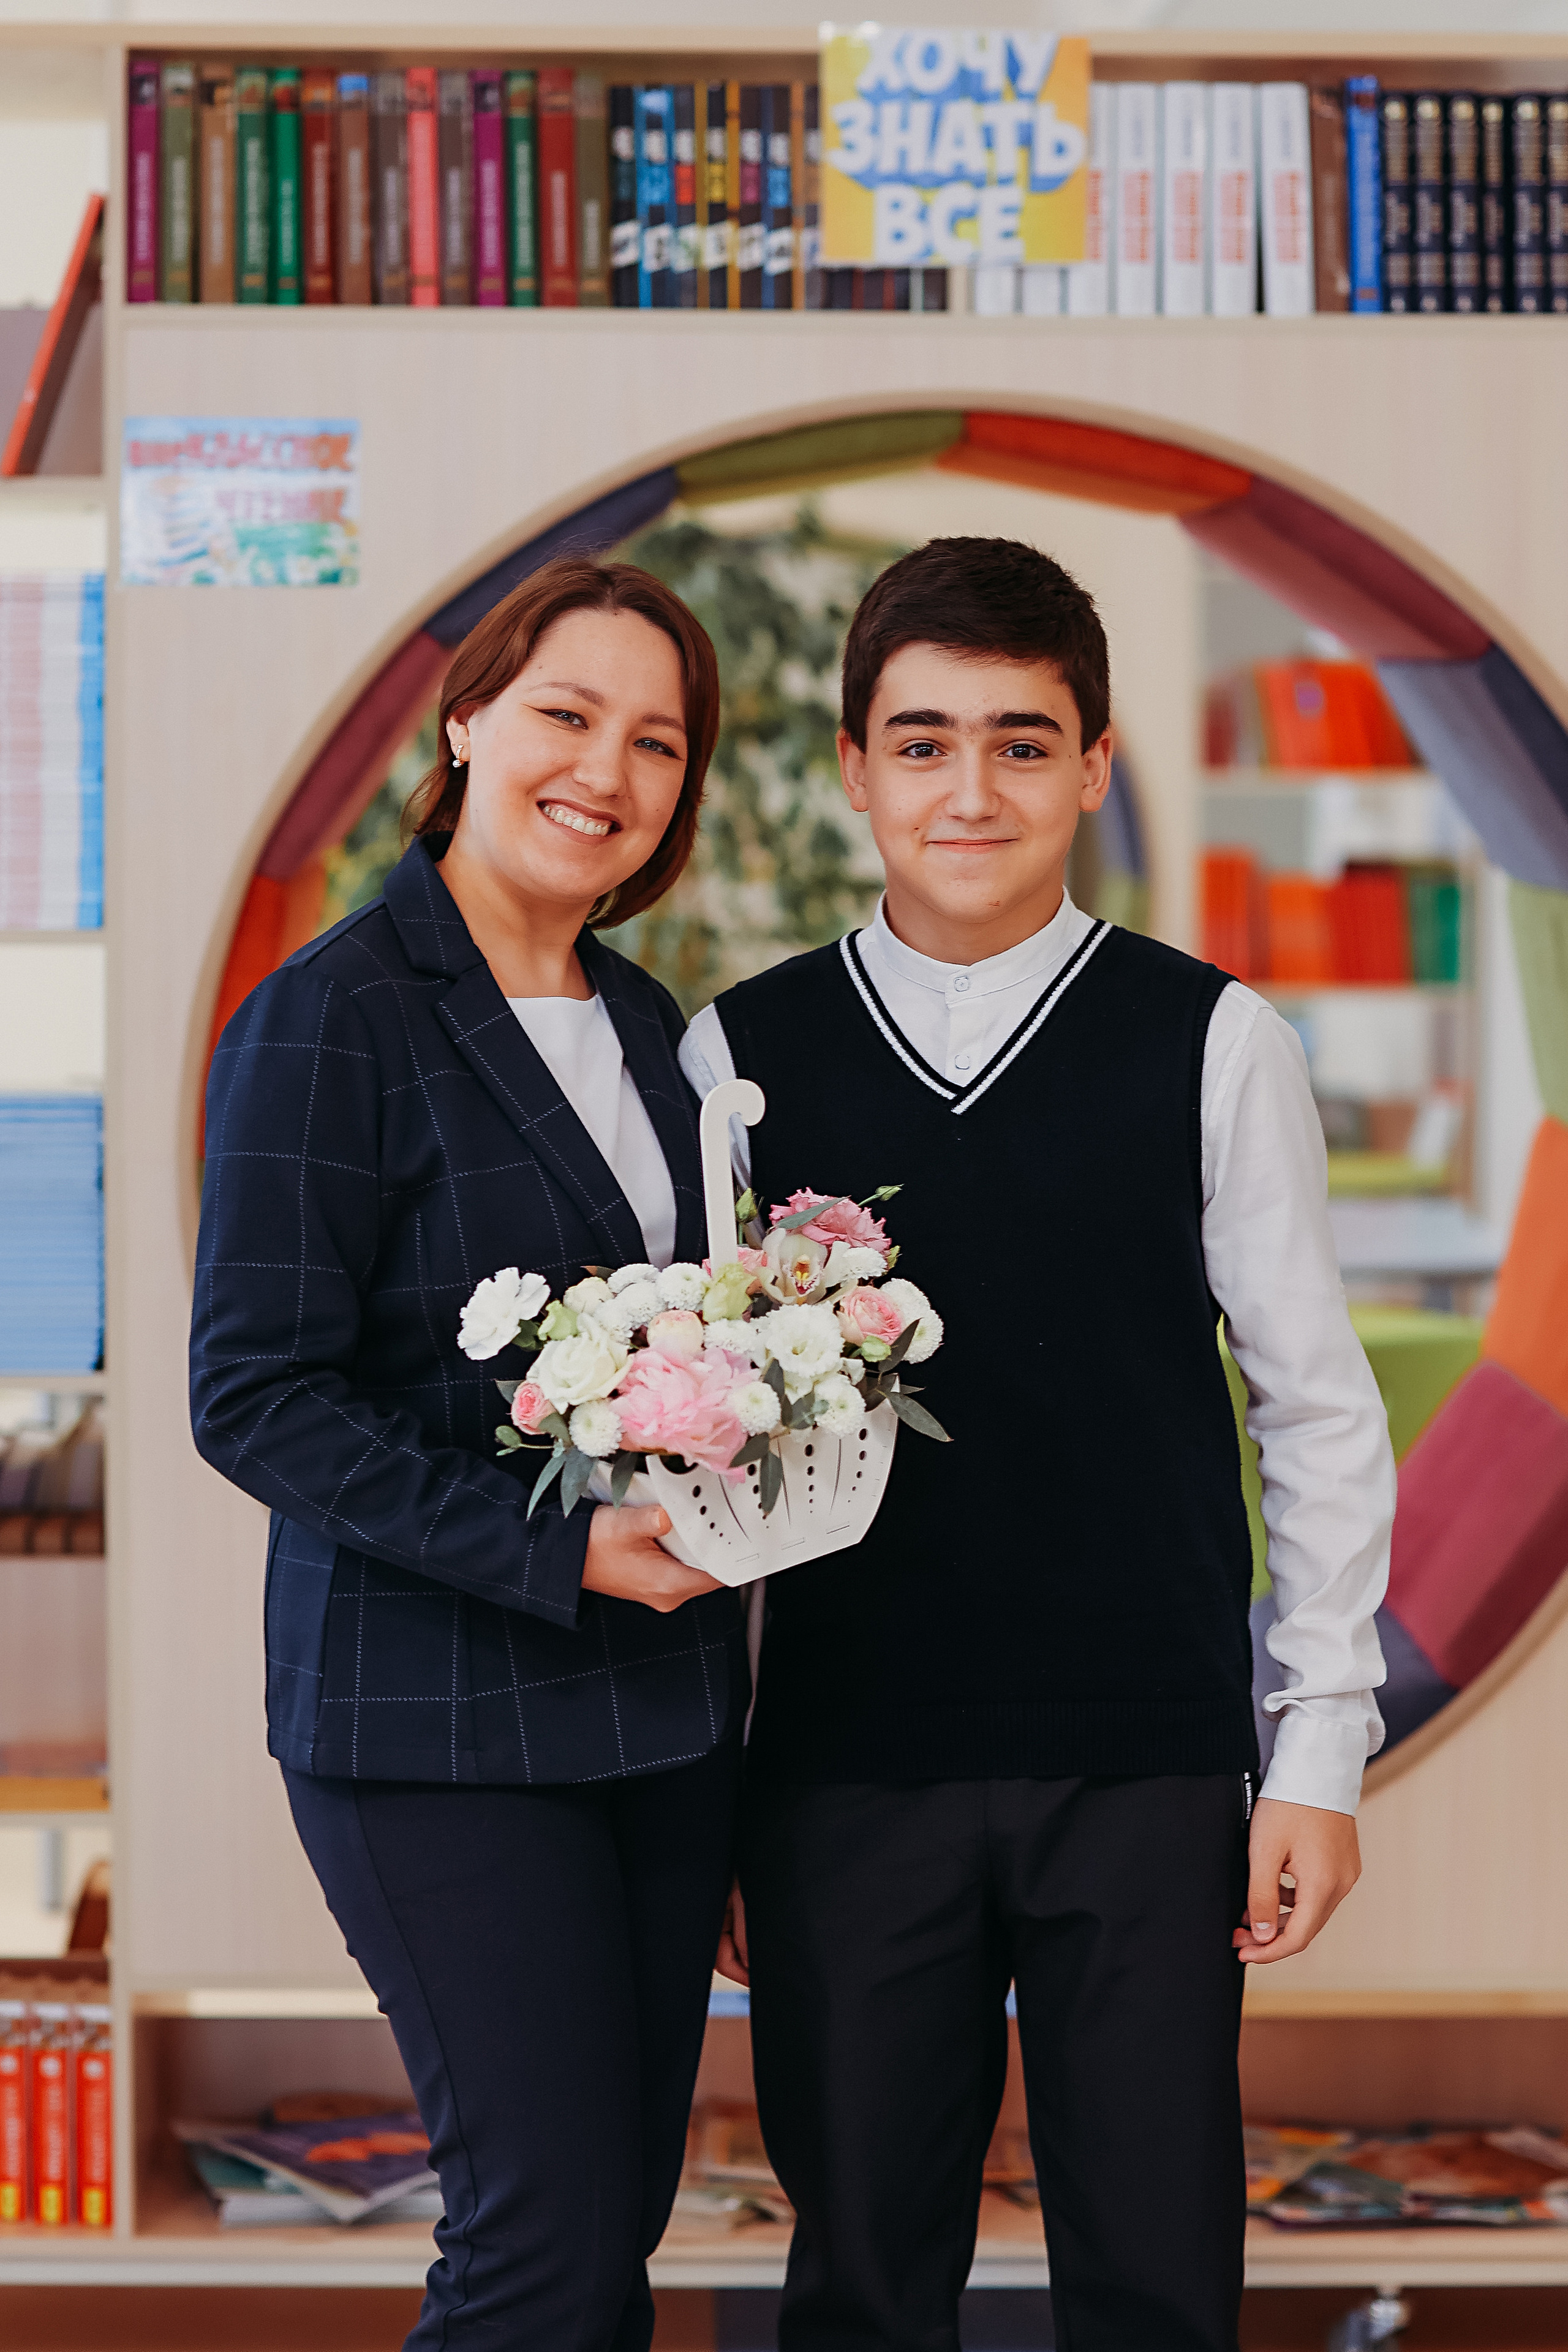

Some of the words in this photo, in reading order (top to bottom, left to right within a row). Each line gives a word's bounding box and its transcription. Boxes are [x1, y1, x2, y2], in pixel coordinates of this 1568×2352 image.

[858, 31, 1057, 94] ХОЧУ
[827, 99, 1088, 176] ЗНАТЬ
[873, 183, 1026, 262] ВСЕ
